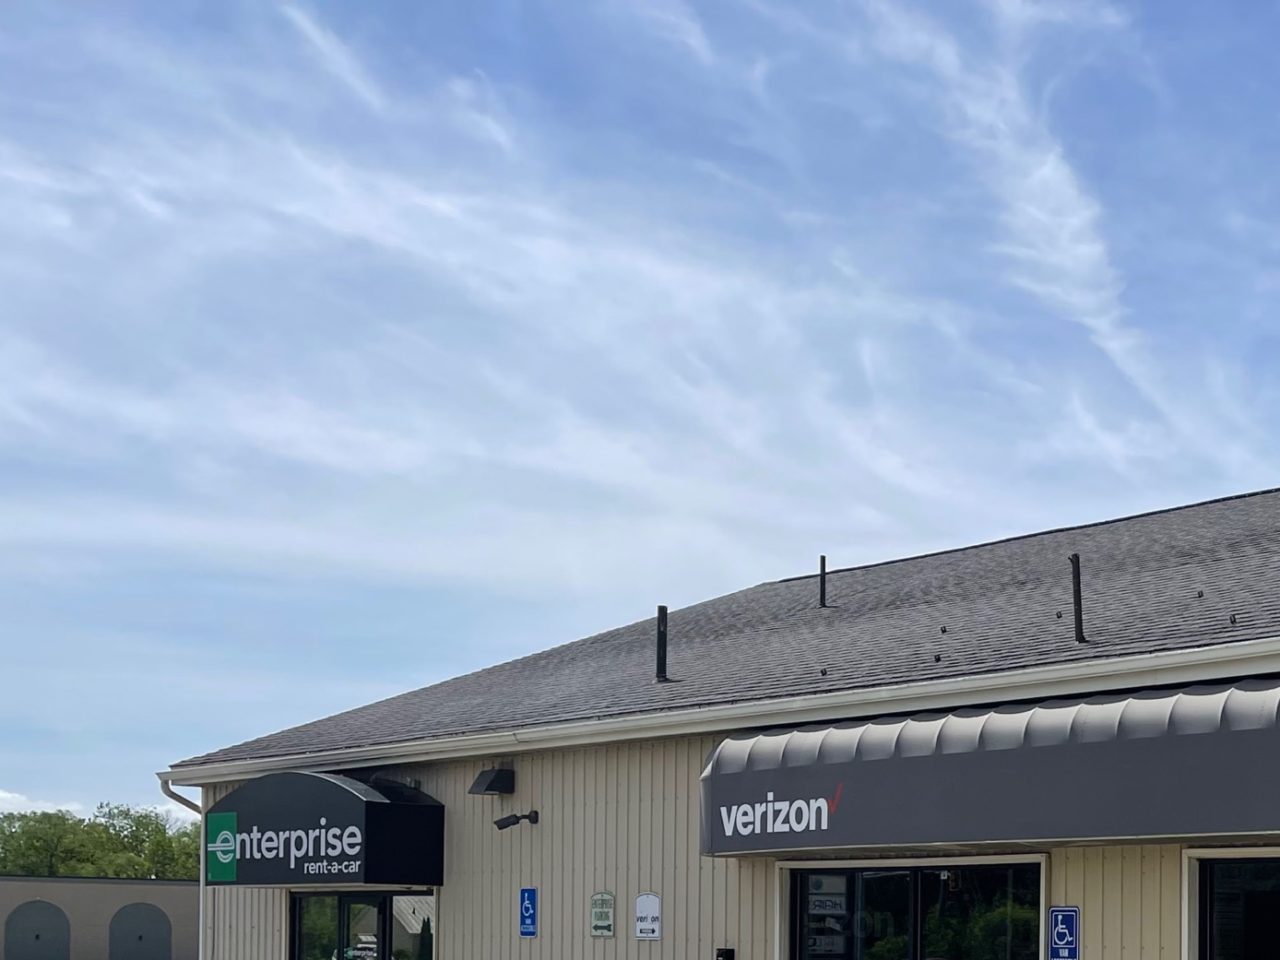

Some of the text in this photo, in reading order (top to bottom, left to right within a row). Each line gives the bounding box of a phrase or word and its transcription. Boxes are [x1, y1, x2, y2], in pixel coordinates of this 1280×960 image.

[720, 791, 829, 836] verizon
[208, 817, 362, 869] enterprise
[304, 859, 361, 874] rent-a-car
